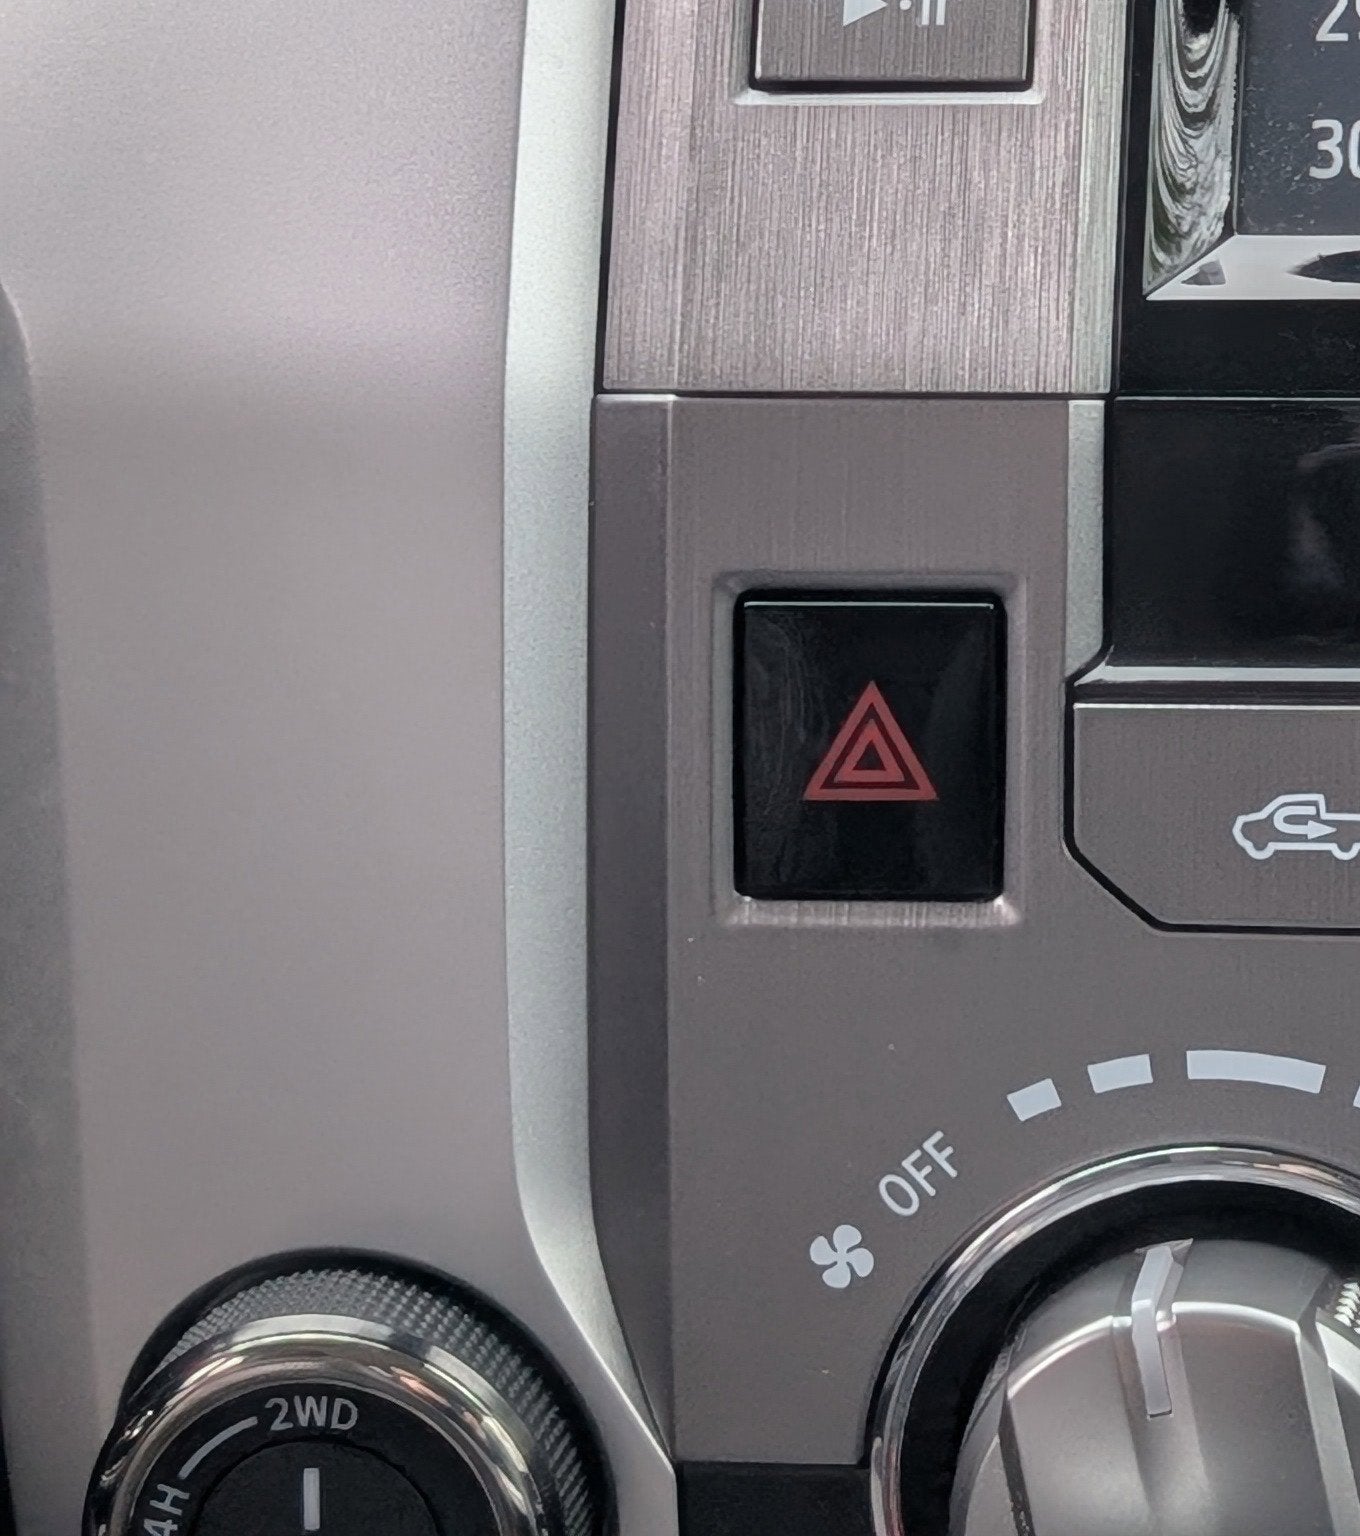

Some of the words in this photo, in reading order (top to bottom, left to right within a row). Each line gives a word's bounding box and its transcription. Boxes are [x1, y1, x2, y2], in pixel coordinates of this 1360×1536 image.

[877, 1130, 959, 1217] OFF
[263, 1395, 359, 1432] 2WD
[143, 1483, 191, 1536] 4H
